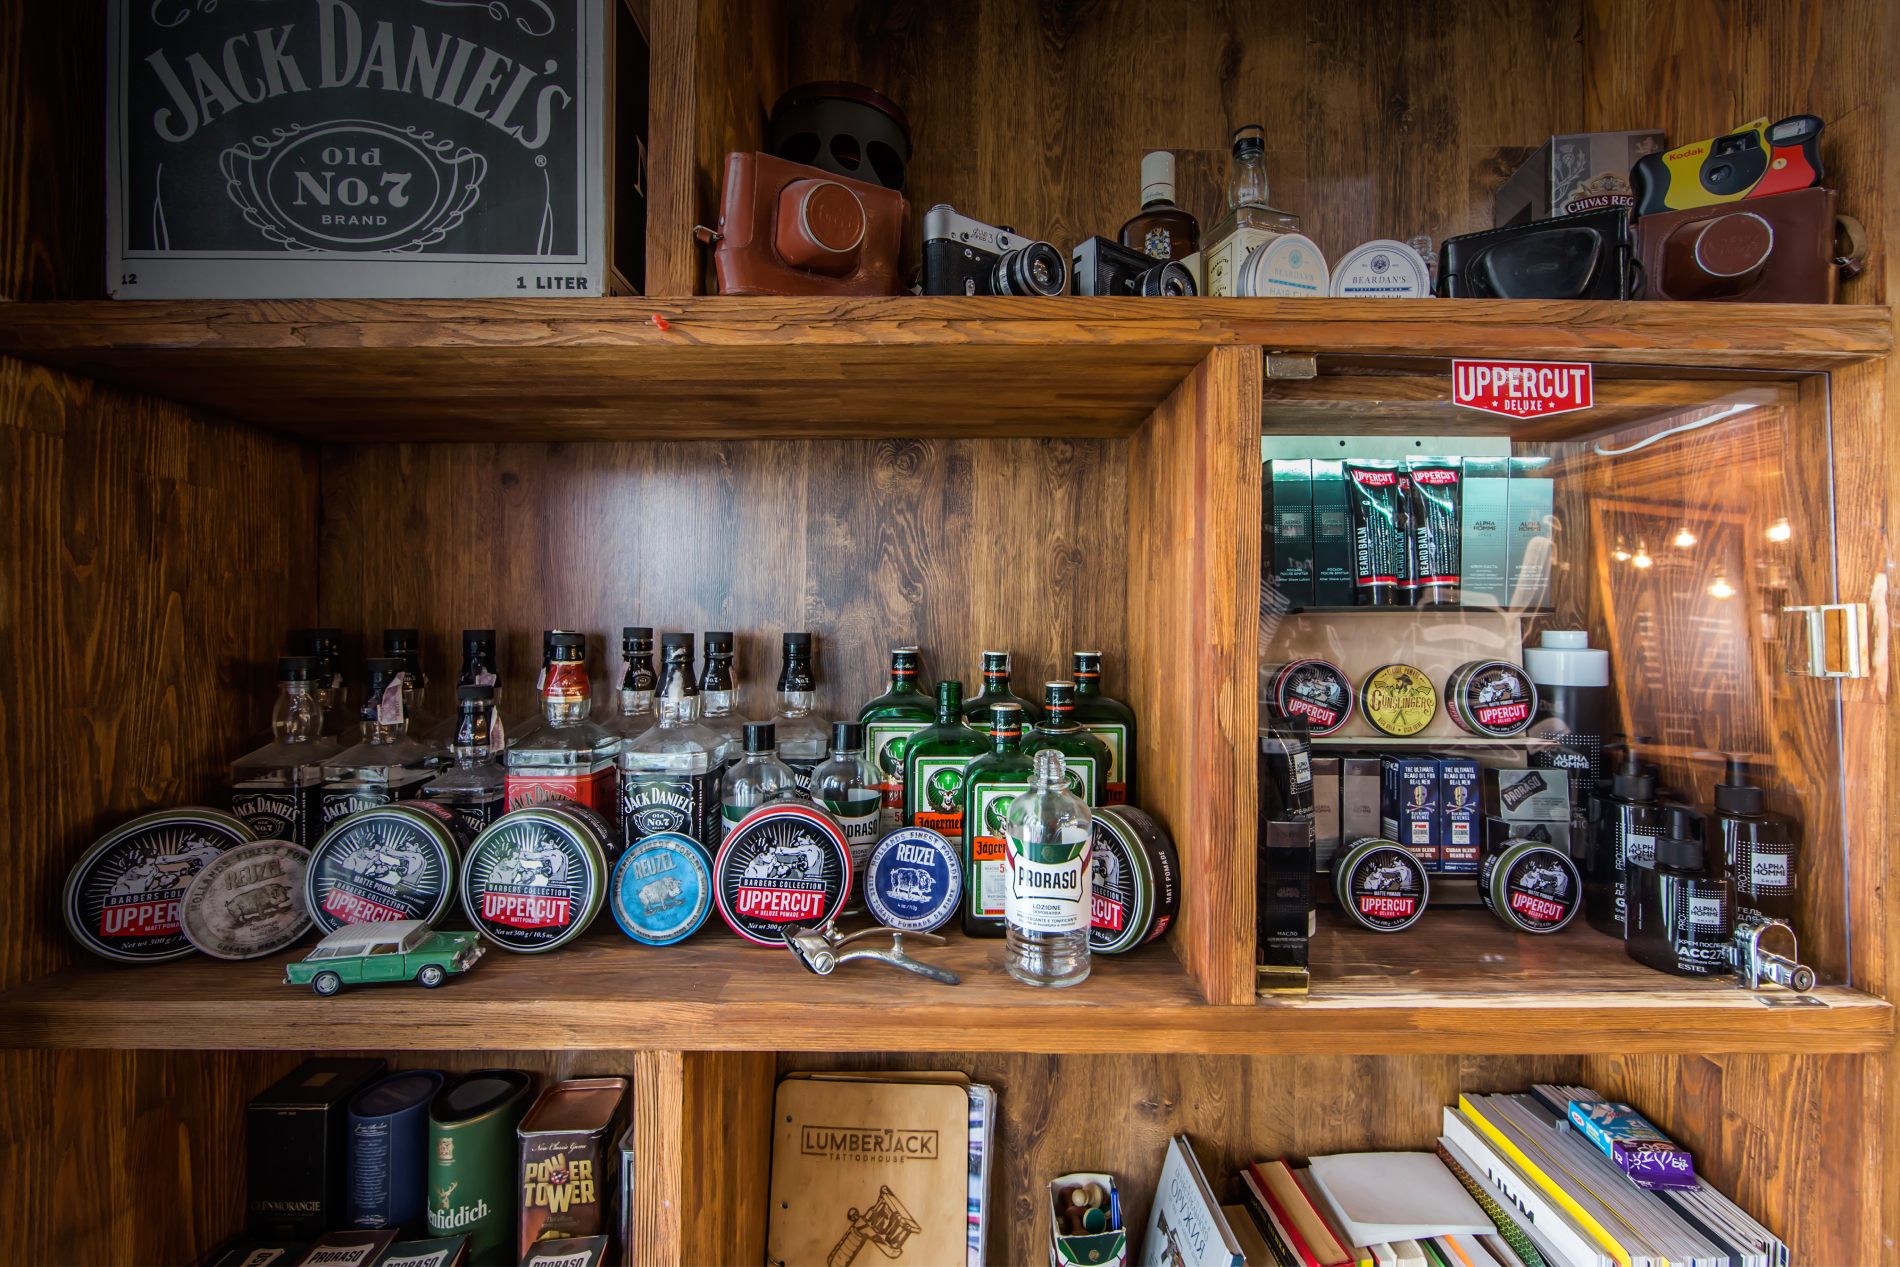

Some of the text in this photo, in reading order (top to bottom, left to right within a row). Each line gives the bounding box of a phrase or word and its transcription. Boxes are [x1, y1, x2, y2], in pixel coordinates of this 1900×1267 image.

[145, 0, 572, 149] JACK DANIEL'S
[321, 146, 382, 166] Old
[1668, 147, 1705, 162] Kodak
[1567, 194, 1634, 214] CHIVAS REG
[321, 213, 388, 226] BRAND
[120, 272, 138, 285] 12
[516, 276, 589, 290] 1 LITER
[1352, 275, 1407, 284] BEARDAN'S
[1458, 366, 1585, 404] UPPERCUT
[1504, 399, 1543, 411] DELUXE
[1354, 471, 1393, 483] UPPERCUT
[1414, 470, 1456, 482] UPPERCUT
[1357, 527, 1369, 576] BEARD BALM
[1417, 527, 1430, 576] BEARD BALM
[1290, 700, 1335, 725] UPPERCUT
[1370, 690, 1434, 716] GUNSLINGERS
[1480, 704, 1526, 723] UPPERCUT
[1554, 760, 1590, 768] HOMME
[624, 788, 696, 814] JACK DANIEL'S
[1504, 775, 1542, 806] PRORASO
[257, 796, 300, 822] DANIEL'S
[323, 802, 348, 822] JACK
[840, 819, 878, 838] ORASO
[632, 851, 677, 880] REUZEL
[872, 832, 958, 880] HOLLANDS FINEST POMADE
[896, 844, 936, 866] REUZEL
[1158, 850, 1172, 882] POMADE
[224, 857, 286, 890] REUZEL
[744, 879, 822, 890] BARBERS COLLECTION
[1019, 866, 1076, 889] PRORASO
[1738, 874, 1747, 893] PRO
[336, 881, 405, 911] BARBERS COLLECTION
[353, 875, 398, 897] MATTE POMADE
[489, 884, 567, 897] BARBERS COLLECTION
[111, 892, 160, 905] BARBERS
[326, 891, 402, 922] UPPERCUT
[485, 895, 568, 922] UPPERCUT
[740, 890, 822, 916] UPPERCUT
[1362, 898, 1413, 914] UPPERCUT
[1512, 893, 1562, 920] UPPERCUT
[105, 902, 180, 934] UPPER
[1091, 896, 1120, 928] RCUT
[1738, 907, 1762, 917] ГЕЛЬ
[144, 923, 162, 932] MATT
[120, 942, 136, 950] Net
[1678, 963, 1708, 973] ESTEL
[806, 1129, 933, 1154] LUMBERJACK
[525, 1152, 593, 1183] POWER
[829, 1154, 906, 1163] TATTOOHOUSE
[524, 1180, 596, 1213] TOWER
[308, 1250, 362, 1264] PRORASO
